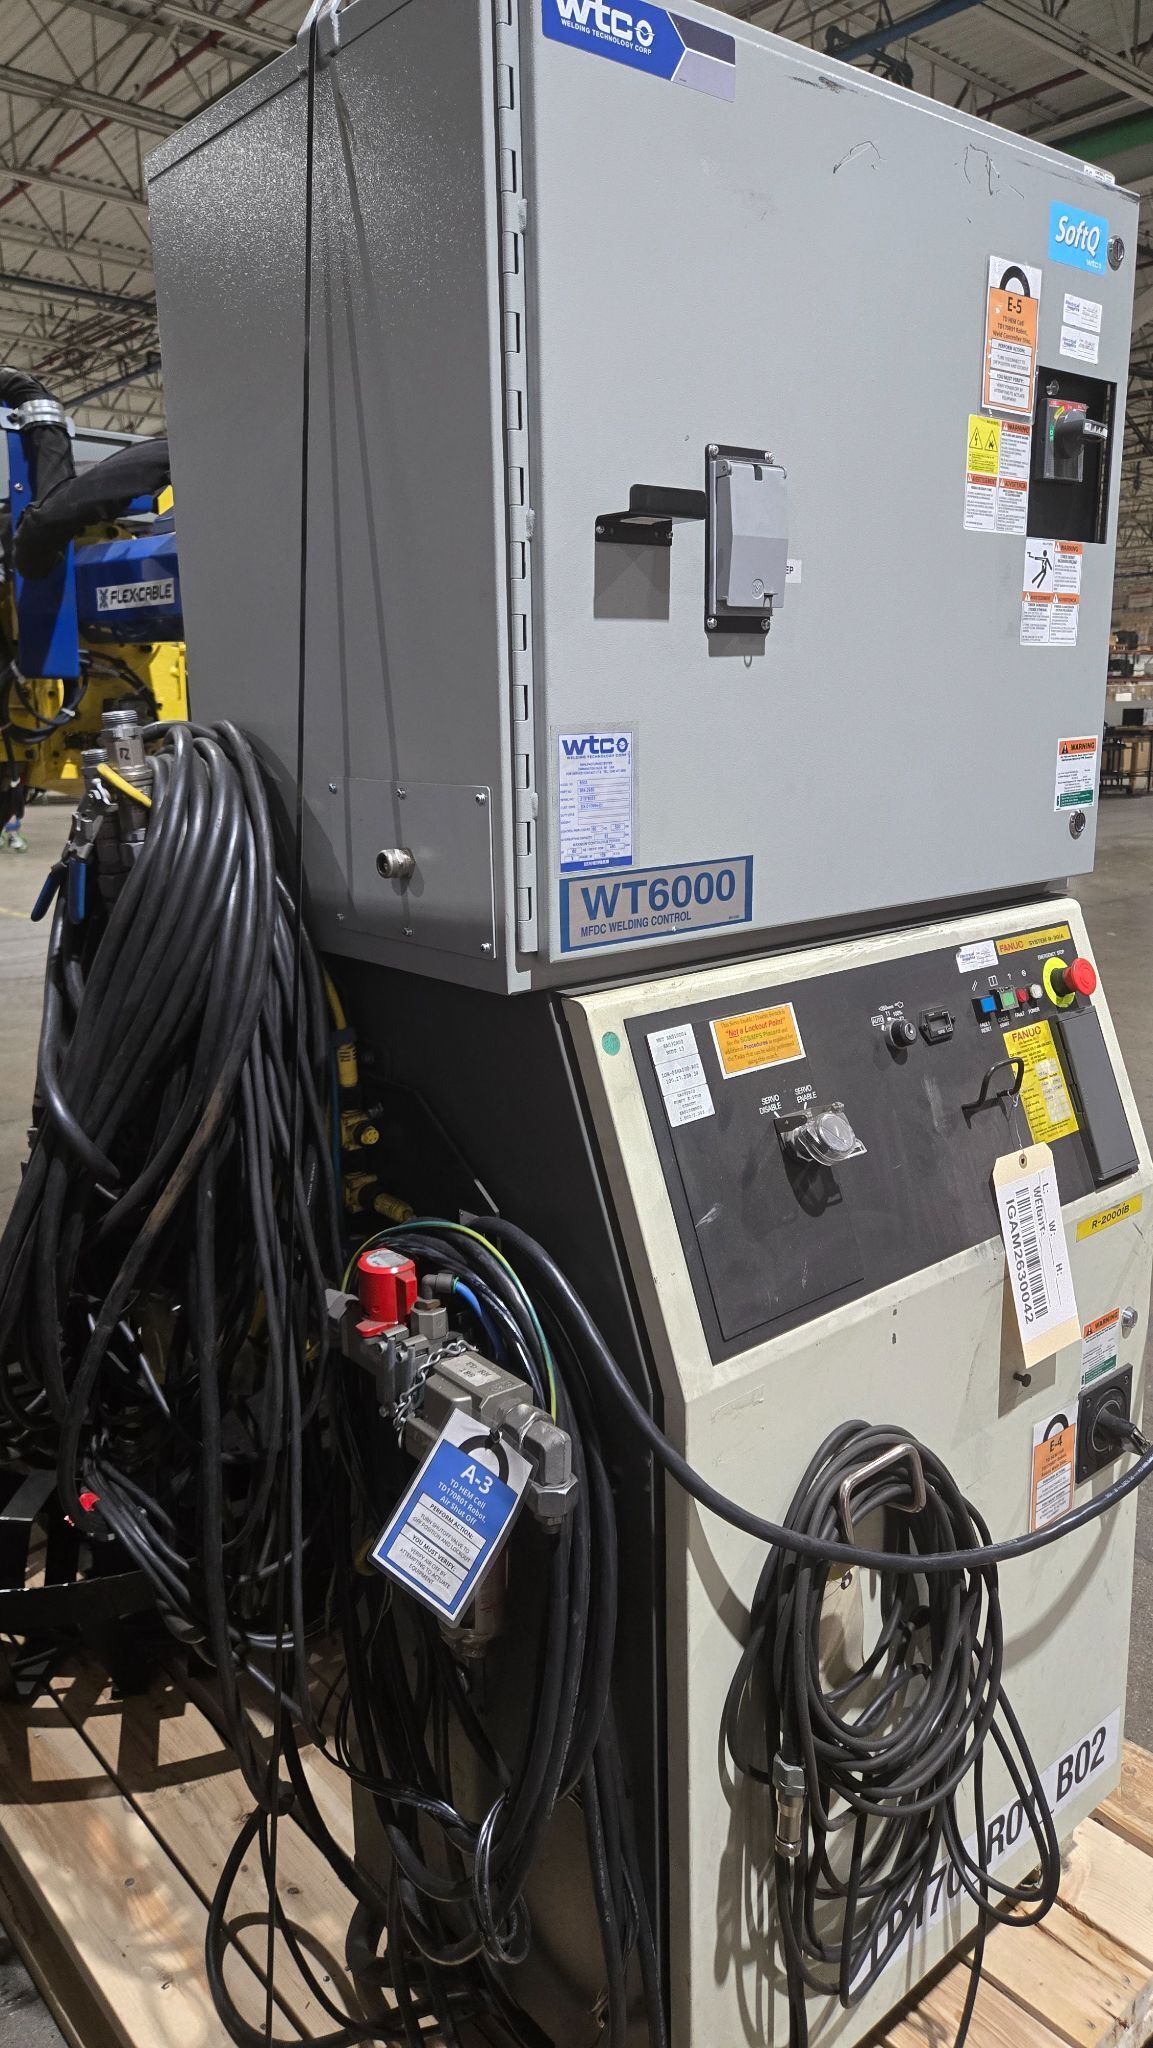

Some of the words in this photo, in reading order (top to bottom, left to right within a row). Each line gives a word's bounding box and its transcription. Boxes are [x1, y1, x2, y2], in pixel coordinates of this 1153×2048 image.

[561, 18, 591, 34] WELDING
[592, 29, 633, 50] TECHNOLOGY
[634, 44, 652, 55] CORP
[1055, 215, 1100, 257] SoftQ
[1008, 297, 1022, 314] E-5
[1008, 423, 1029, 434] WARNING
[1060, 545, 1078, 553] WARNING
[1070, 742, 1095, 751] WARNING
[581, 869, 736, 921] WT6000
[581, 923, 607, 937] MFDC
[609, 916, 649, 933] WELDING
[651, 911, 692, 926] CONTROL
[999, 940, 1024, 953] FANUC
[1028, 937, 1047, 946] SYSTEM
[744, 1022, 768, 1033] Lockout
[768, 1017, 786, 1028] Point"
[763, 1029, 781, 1037] Placard
[1011, 1026, 1042, 1042] FANUC
[743, 1041, 768, 1050] Procedures
[759, 1102, 782, 1115] DISABLE
[796, 1091, 818, 1104] ENABLE
[762, 1094, 780, 1106] SERVO
[794, 1084, 813, 1096] SERVO
[1005, 1198, 1034, 1324] IGAM2630042
[1048, 1220, 1056, 1236] W:
[1056, 1262, 1063, 1277] H:
[1095, 1311, 1118, 1328] WARNING
[1050, 1435, 1062, 1452] E-4
[460, 1464, 493, 1495] A-3
[438, 1482, 468, 1508] TD170R01
[468, 1503, 487, 1524] Robot,
[450, 1478, 460, 1490] TD
[458, 1483, 474, 1500] HEM
[473, 1496, 486, 1510] Cell
[429, 1503, 454, 1525] PERFORM
[453, 1520, 474, 1540] ACTION:
[440, 1495, 450, 1506] Air
[450, 1501, 466, 1517] Shut
[464, 1512, 478, 1526] Off
[412, 1517, 422, 1526] OFF
[421, 1522, 442, 1541] POSITION
[440, 1537, 451, 1548] AND
[450, 1543, 471, 1563] LOCKOUT
[419, 1512, 433, 1525] TURN
[432, 1520, 451, 1539] SHUTOFF
[450, 1533, 464, 1549] VALVE
[463, 1545, 470, 1554] TO
[410, 1546, 424, 1559] VERIFY
[422, 1555, 431, 1565] AIR
[430, 1560, 440, 1572] OFF
[439, 1569, 447, 1578] BY
[412, 1534, 424, 1547] YOU
[422, 1542, 438, 1558] MUST
[436, 1552, 457, 1572] VERIFY:
[399, 1548, 426, 1572] ATTEMPTING
[425, 1568, 432, 1576] TO
[430, 1572, 451, 1590] ACTUATE
[409, 1564, 434, 1585] EQUIPMENT
